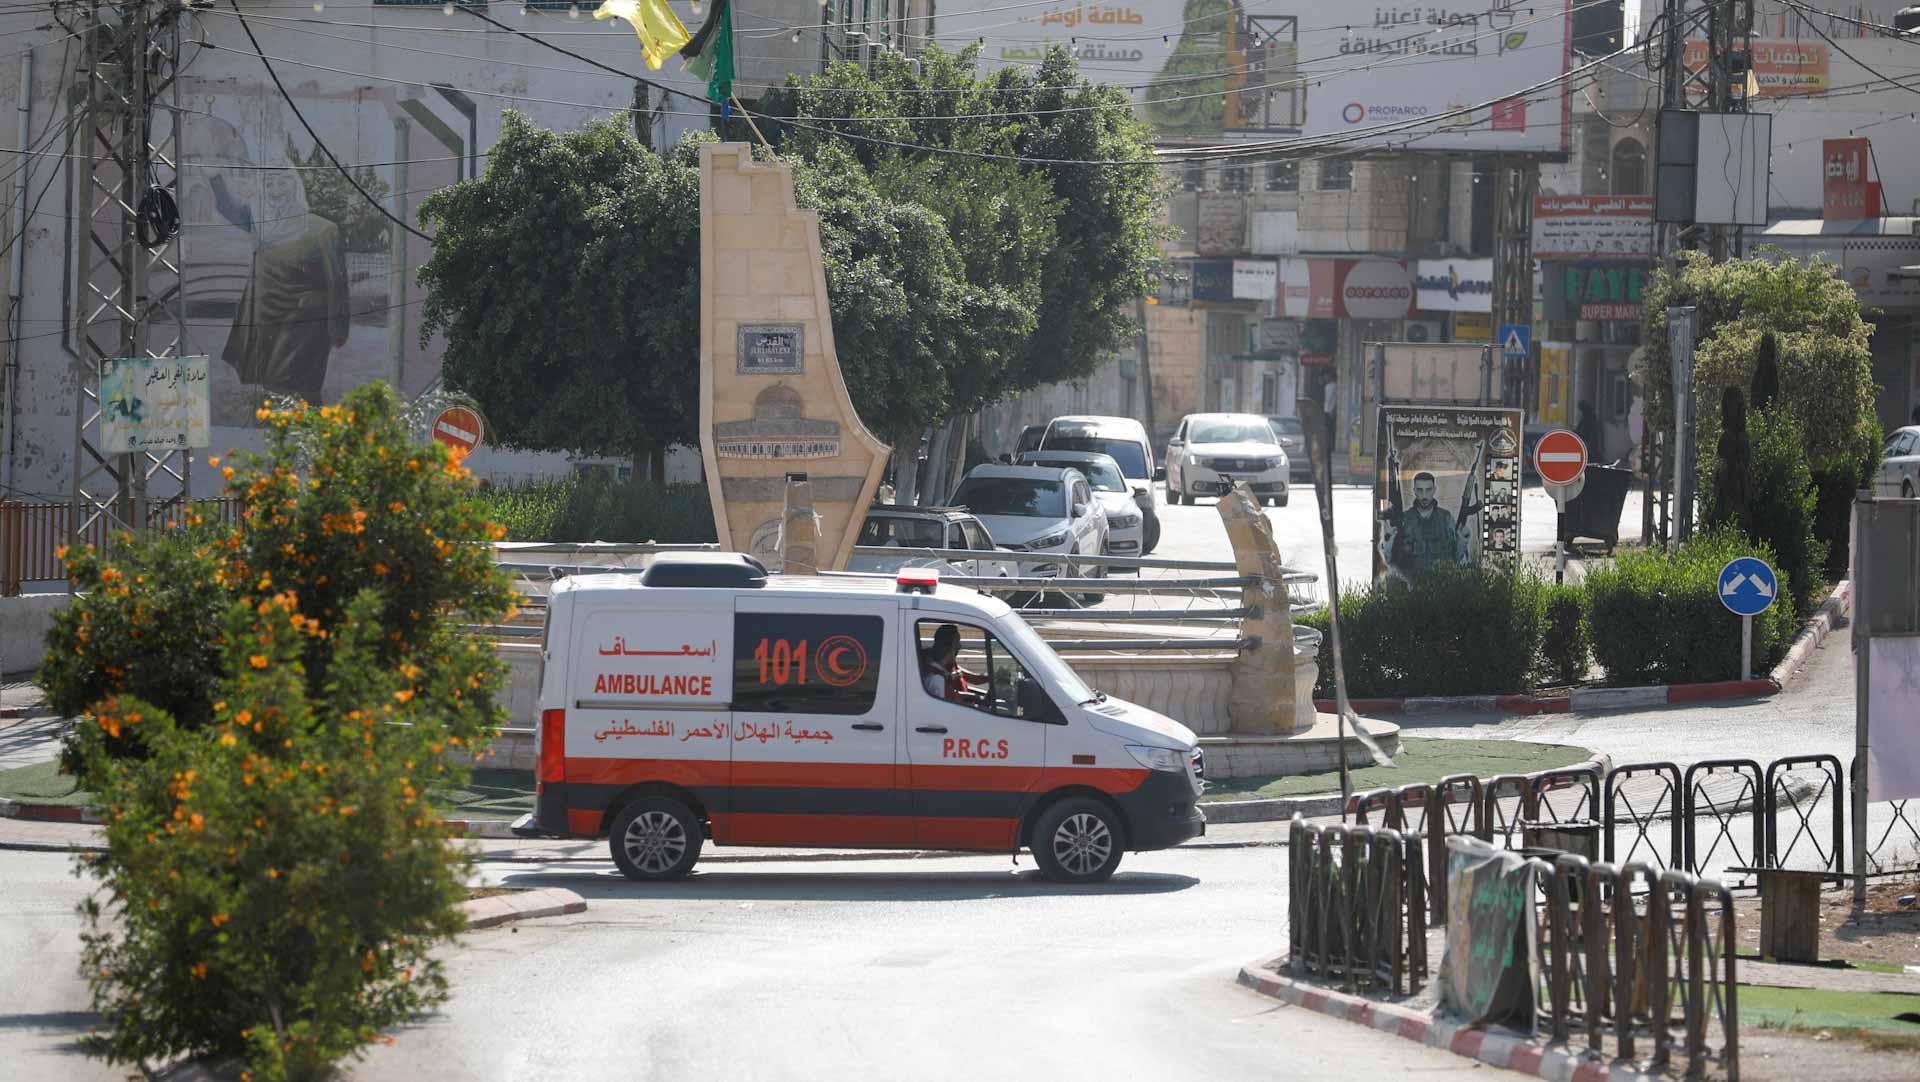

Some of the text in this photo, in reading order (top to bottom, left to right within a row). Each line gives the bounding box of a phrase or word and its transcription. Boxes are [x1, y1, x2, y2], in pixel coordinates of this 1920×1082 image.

[1088, 6, 1143, 25] طاقة
[1374, 7, 1479, 30] حملة تعزيز
[1339, 37, 1410, 55] الطاقة
[1754, 47, 1820, 69] تصفيات
[1368, 105, 1428, 116] PROPARCO
[1345, 286, 1409, 299] ooredoo
[1581, 305, 1648, 320] SUPER MARK
[756, 335, 784, 346] القدس
[186, 367, 206, 381] صلاة
[598, 636, 717, 662] إسعاف
[754, 638, 807, 686] 101
[594, 673, 713, 696] AMBULANCE
[594, 719, 833, 744] جمعية الهلال الأحمر الفلسطيني
[943, 738, 1009, 760] P.R.C.S
